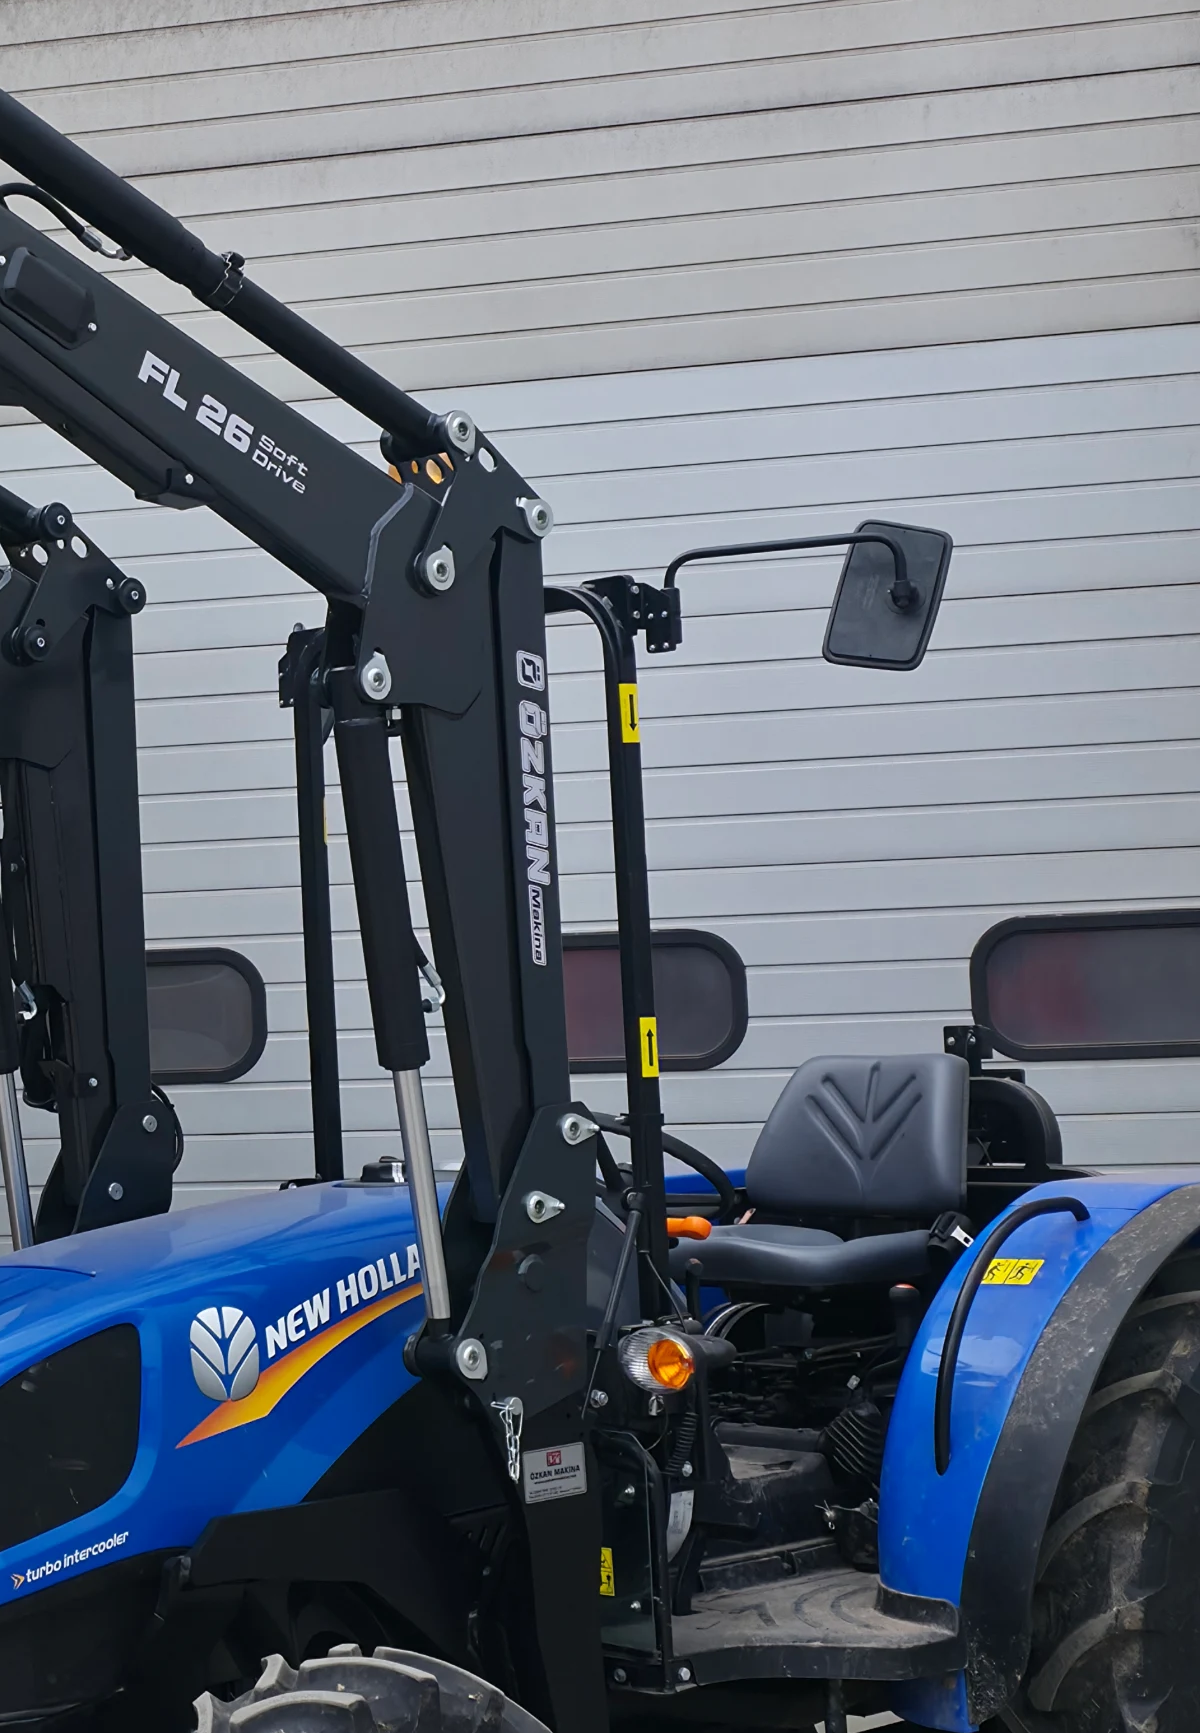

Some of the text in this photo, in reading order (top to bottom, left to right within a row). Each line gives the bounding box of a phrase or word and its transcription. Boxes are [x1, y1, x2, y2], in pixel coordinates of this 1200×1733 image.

[137, 350, 255, 454] FL 26
[251, 449, 306, 494] Drive
[258, 434, 309, 477] Soft
[519, 700, 550, 885] ÖZKAN
[531, 888, 543, 961] Makina
[265, 1287, 330, 1359] NEW
[25, 1531, 129, 1583] turbo intercooler
